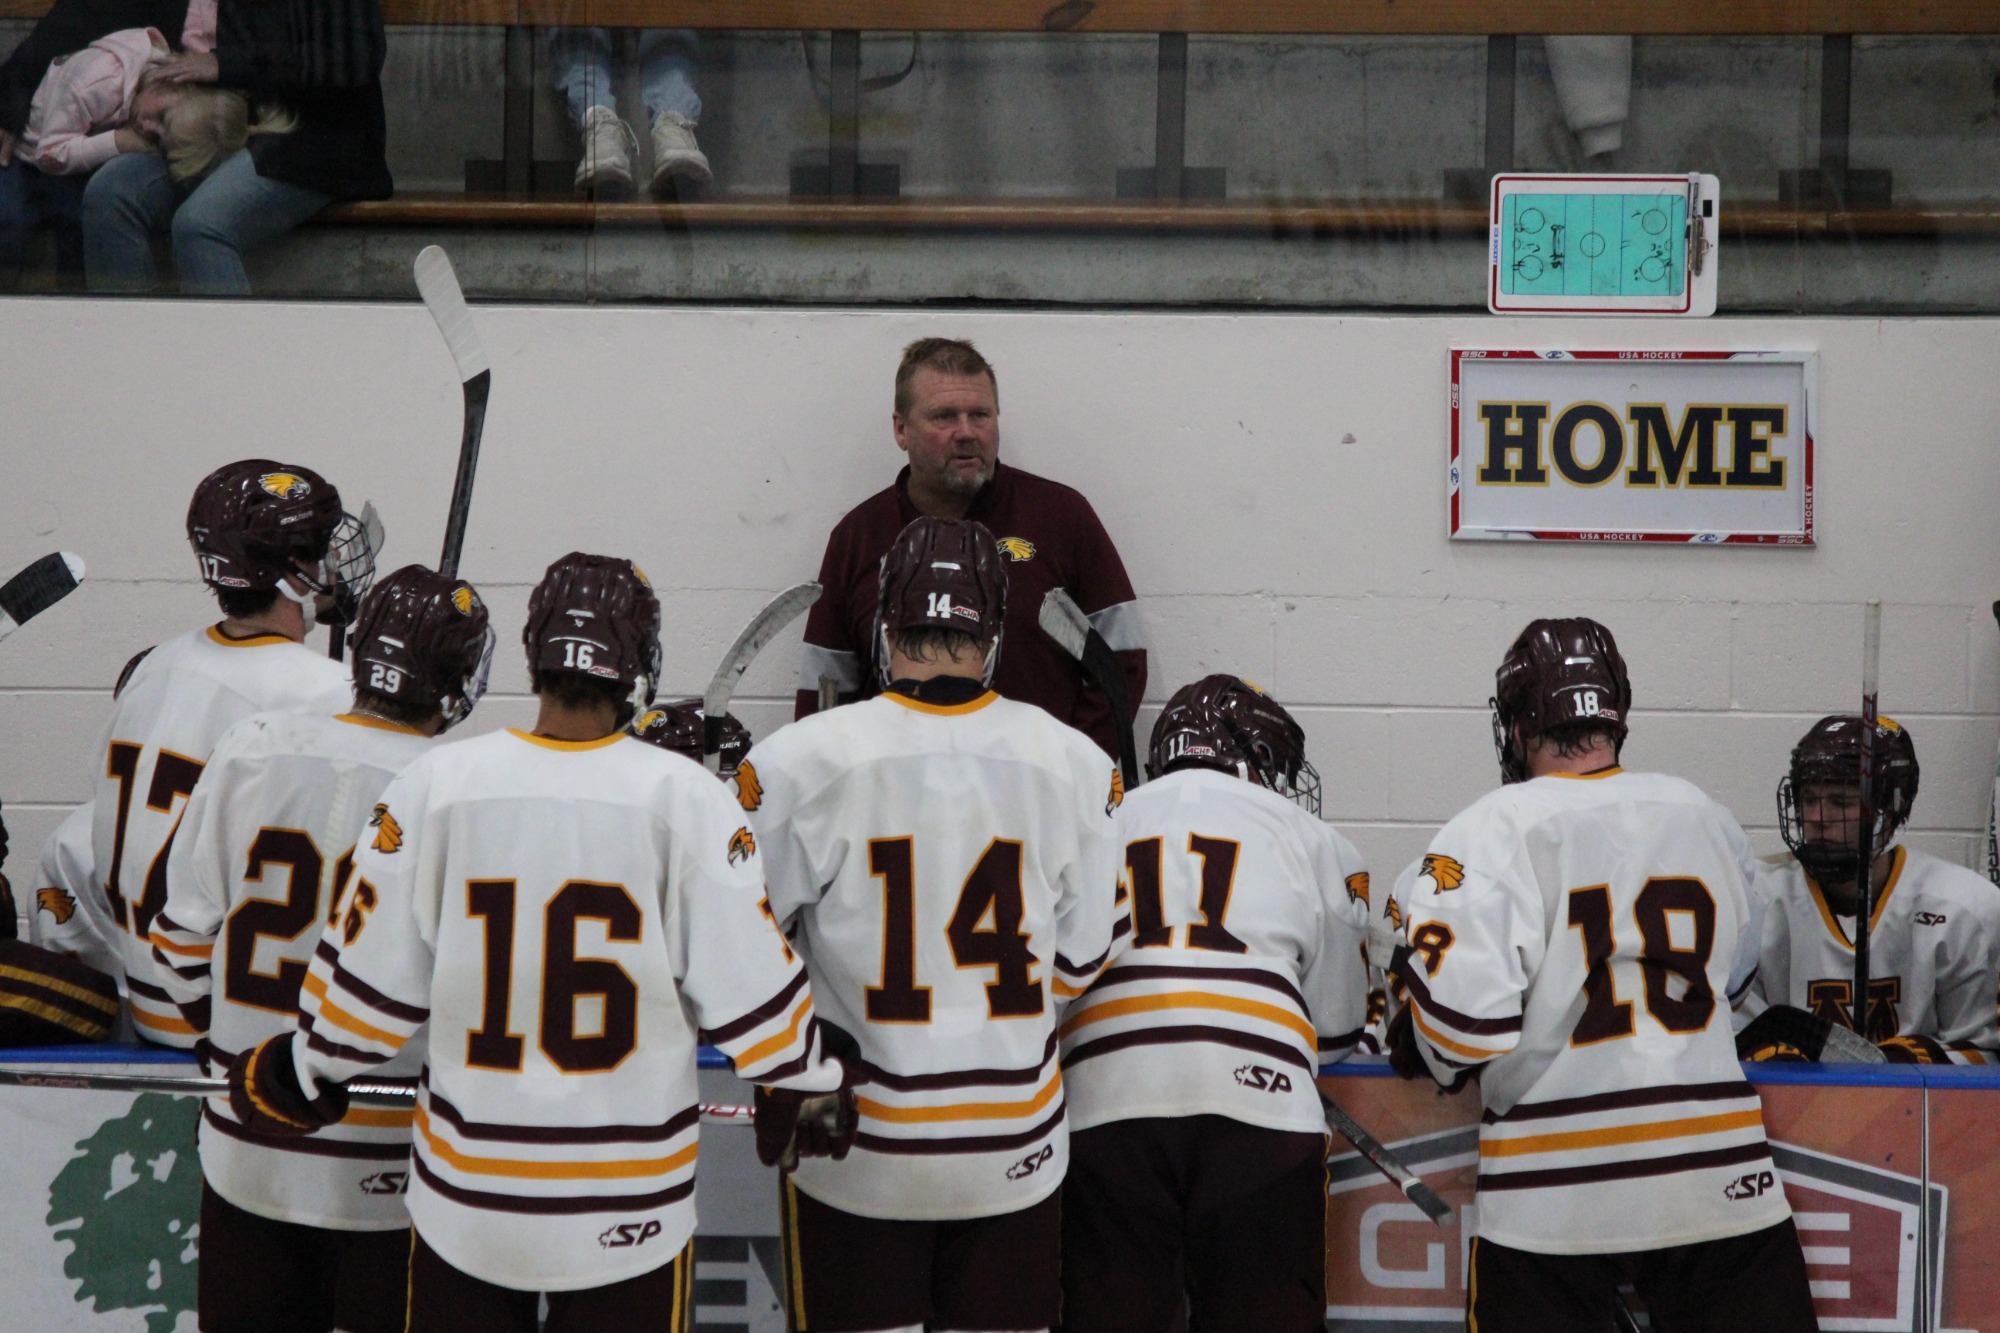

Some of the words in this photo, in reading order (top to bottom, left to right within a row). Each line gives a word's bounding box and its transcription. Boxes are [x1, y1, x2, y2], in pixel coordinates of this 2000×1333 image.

[1476, 400, 1788, 490] HOME
[200, 556, 219, 581] 17
[926, 592, 951, 619] 14
[563, 642, 594, 670] 16
[370, 664, 401, 695] 29
[1573, 691, 1599, 717] 18
[1168, 733, 1185, 761] 11
[107, 740, 214, 943] 17
[1125, 831, 1249, 954] 11
[863, 835, 1045, 1025] 14
[465, 878, 643, 1074] 16
[1566, 875, 1716, 1048] 18
[1245, 1065, 1293, 1093] SP
[1014, 1143, 1054, 1180] SP
[1733, 1171, 1775, 1200] SP
[608, 1220, 662, 1249] SP
